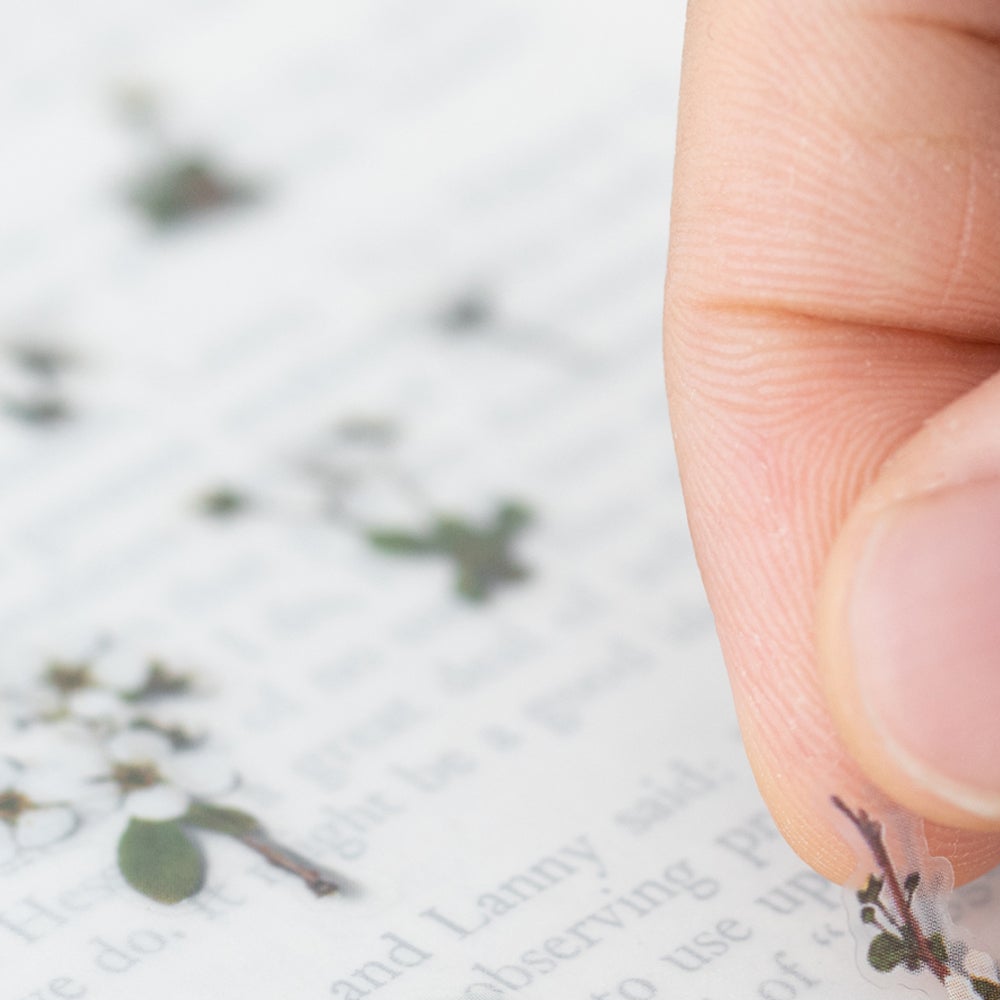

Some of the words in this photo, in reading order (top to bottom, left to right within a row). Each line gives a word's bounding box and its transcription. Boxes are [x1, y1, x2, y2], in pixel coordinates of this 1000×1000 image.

[418, 833, 609, 941] Lanny
[612, 757, 734, 837] said:
[87, 929, 187, 974] do.
[659, 918, 754, 974] use
